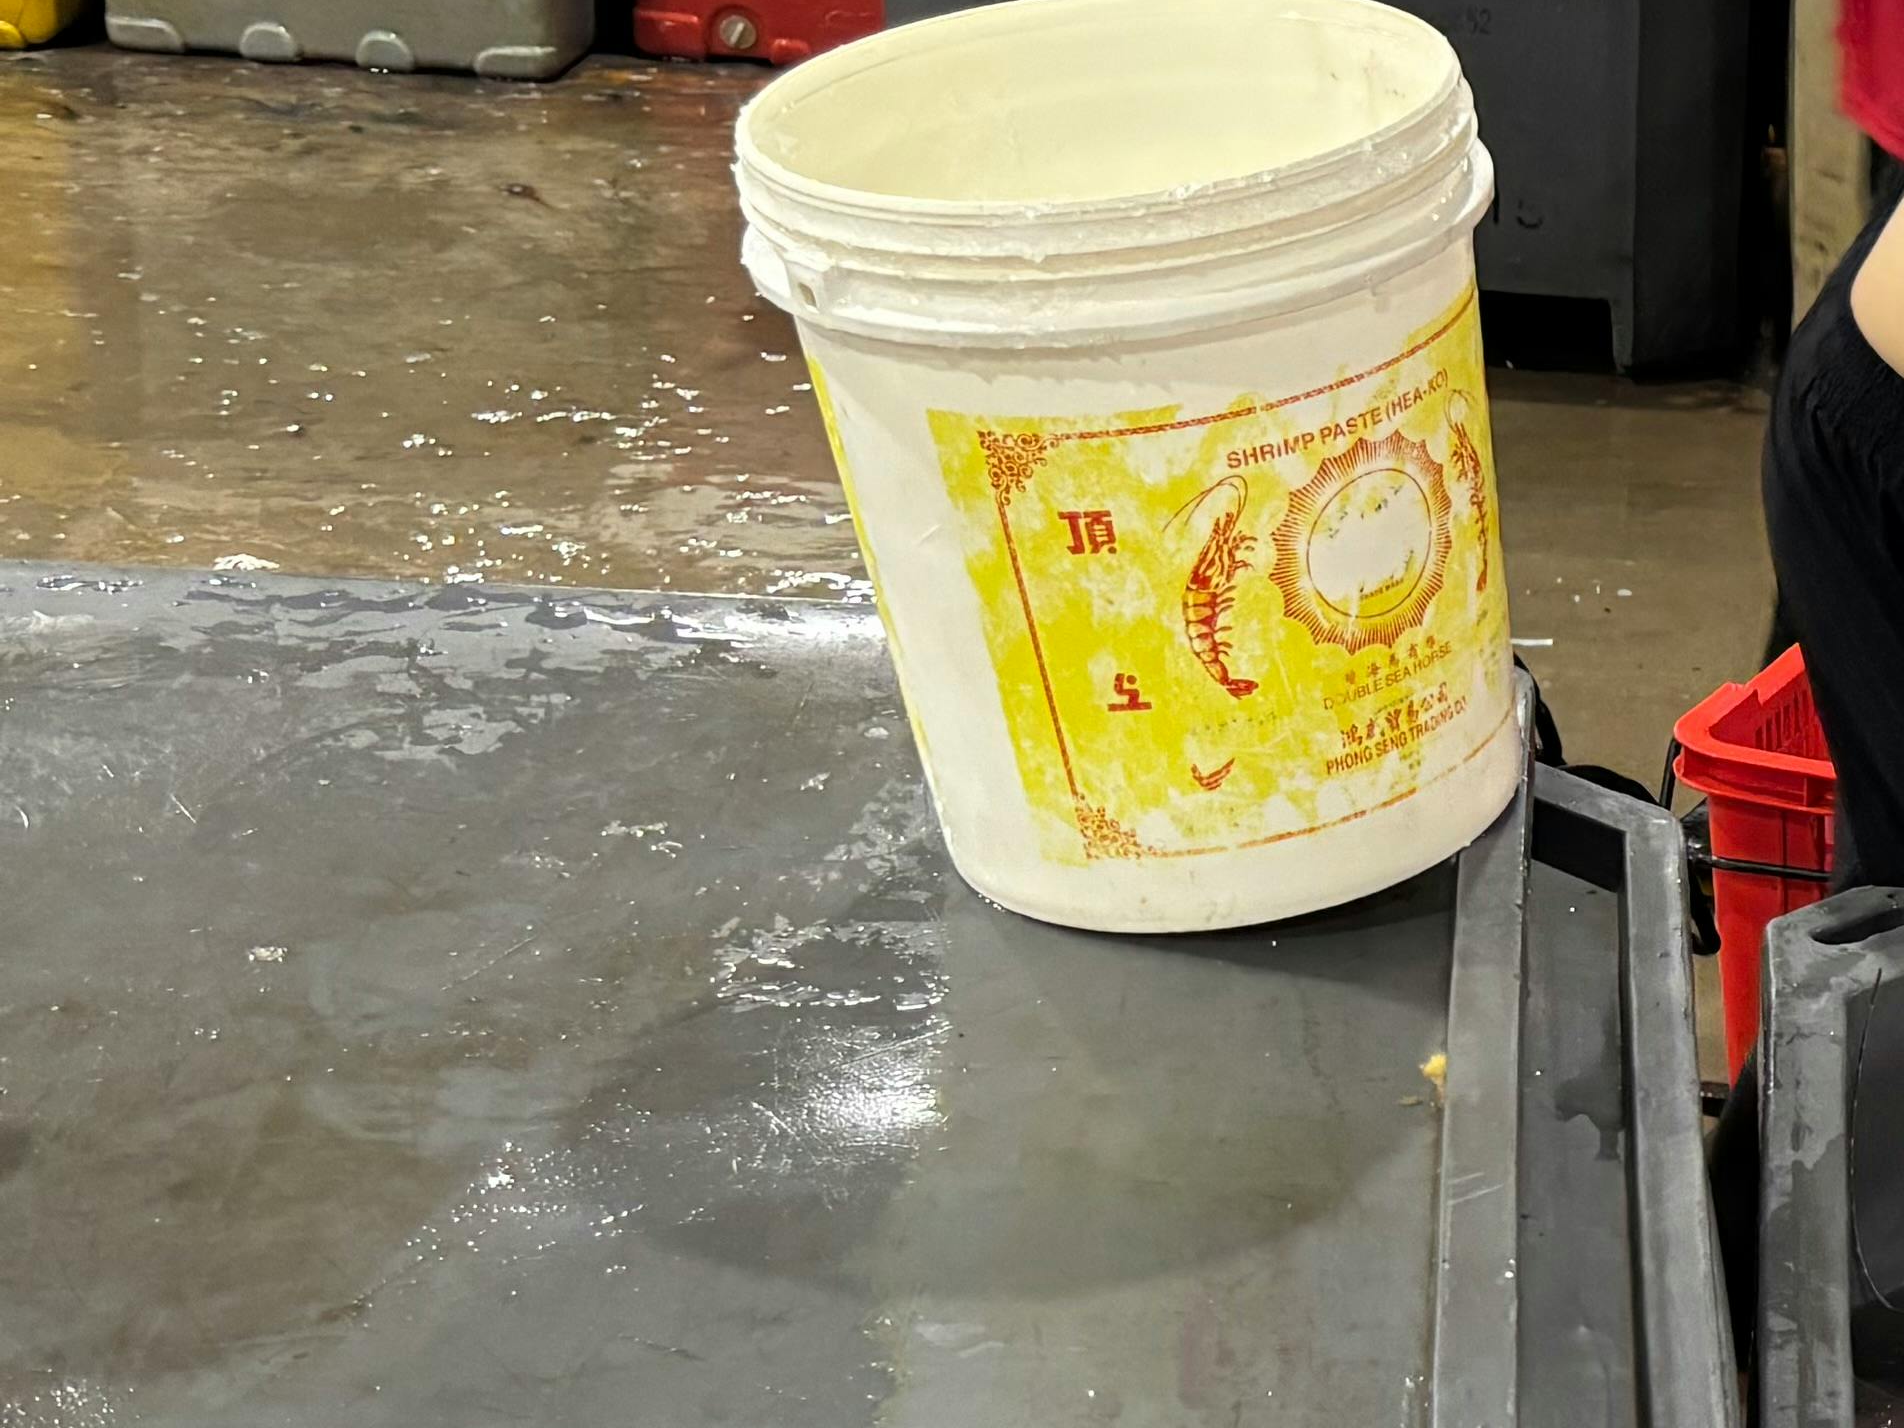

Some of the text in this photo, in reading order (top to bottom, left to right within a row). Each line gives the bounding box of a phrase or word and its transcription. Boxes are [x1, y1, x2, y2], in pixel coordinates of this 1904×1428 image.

[1226, 431, 1316, 470] SHRIMP
[1319, 406, 1384, 445] PASTE
[1385, 664, 1412, 688] SEA
[1412, 640, 1453, 676] HORSE
[1326, 745, 1374, 776] PHONG
[1374, 731, 1408, 758] SENG
